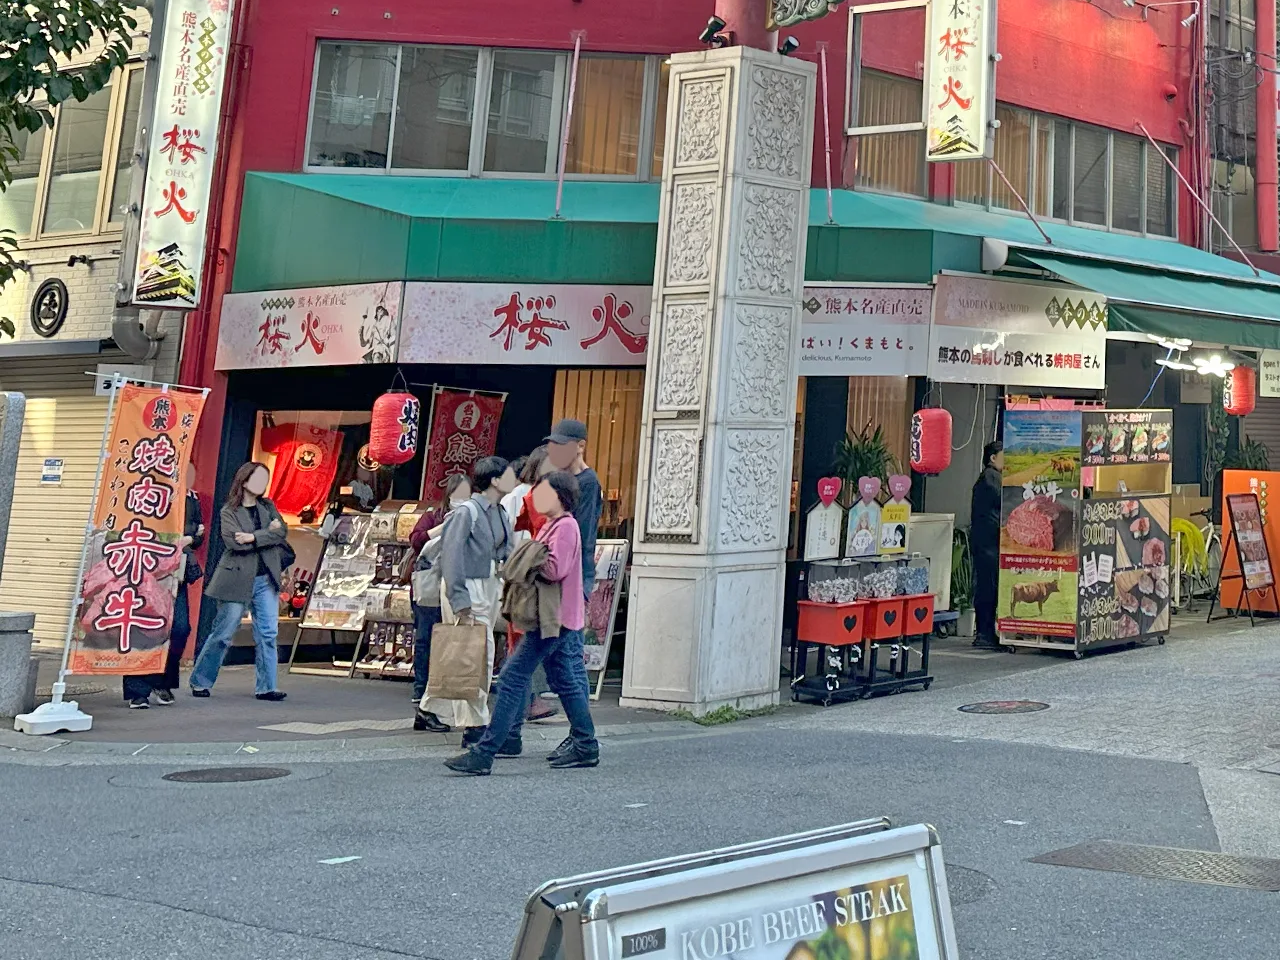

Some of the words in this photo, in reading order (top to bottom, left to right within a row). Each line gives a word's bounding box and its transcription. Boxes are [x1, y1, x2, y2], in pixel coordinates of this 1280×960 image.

[170, 10, 198, 116] 熊本名産直売
[938, 27, 977, 110] 桜火
[154, 123, 207, 225] 桜火
[165, 167, 195, 180] OHKA
[320, 323, 344, 335] OHKA
[489, 291, 650, 354] 桜火
[825, 297, 923, 316] 熊本名産直売
[256, 310, 326, 356] 桜火
[834, 354, 872, 362] Kumamoto
[151, 398, 171, 431] 熊本
[94, 433, 176, 654] 焼肉赤牛
[629, 932, 659, 952] 100%
[680, 917, 756, 960] KOBE
[763, 899, 829, 945] BEEF
[833, 882, 909, 927] STEAK
